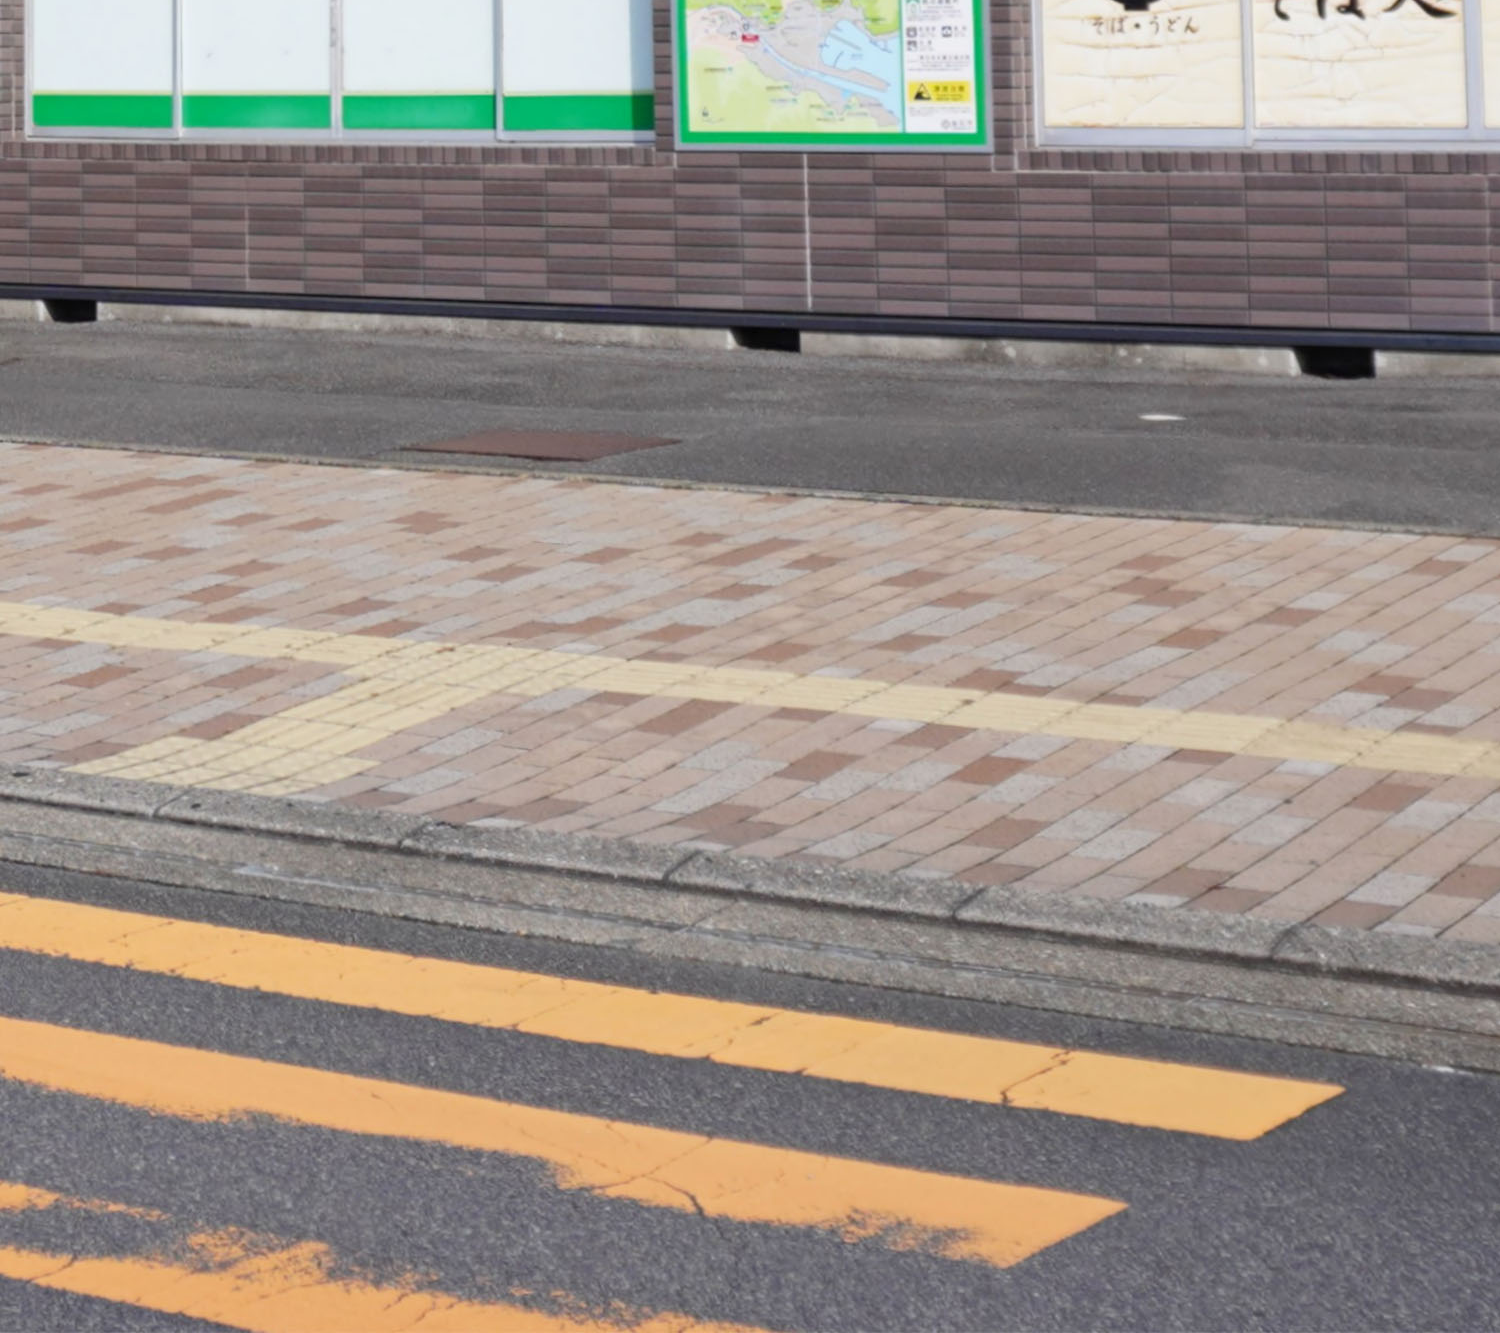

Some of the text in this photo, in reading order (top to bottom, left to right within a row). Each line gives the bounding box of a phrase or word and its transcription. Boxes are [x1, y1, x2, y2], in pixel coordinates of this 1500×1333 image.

[1091, 16, 1200, 35] そば・うどん
